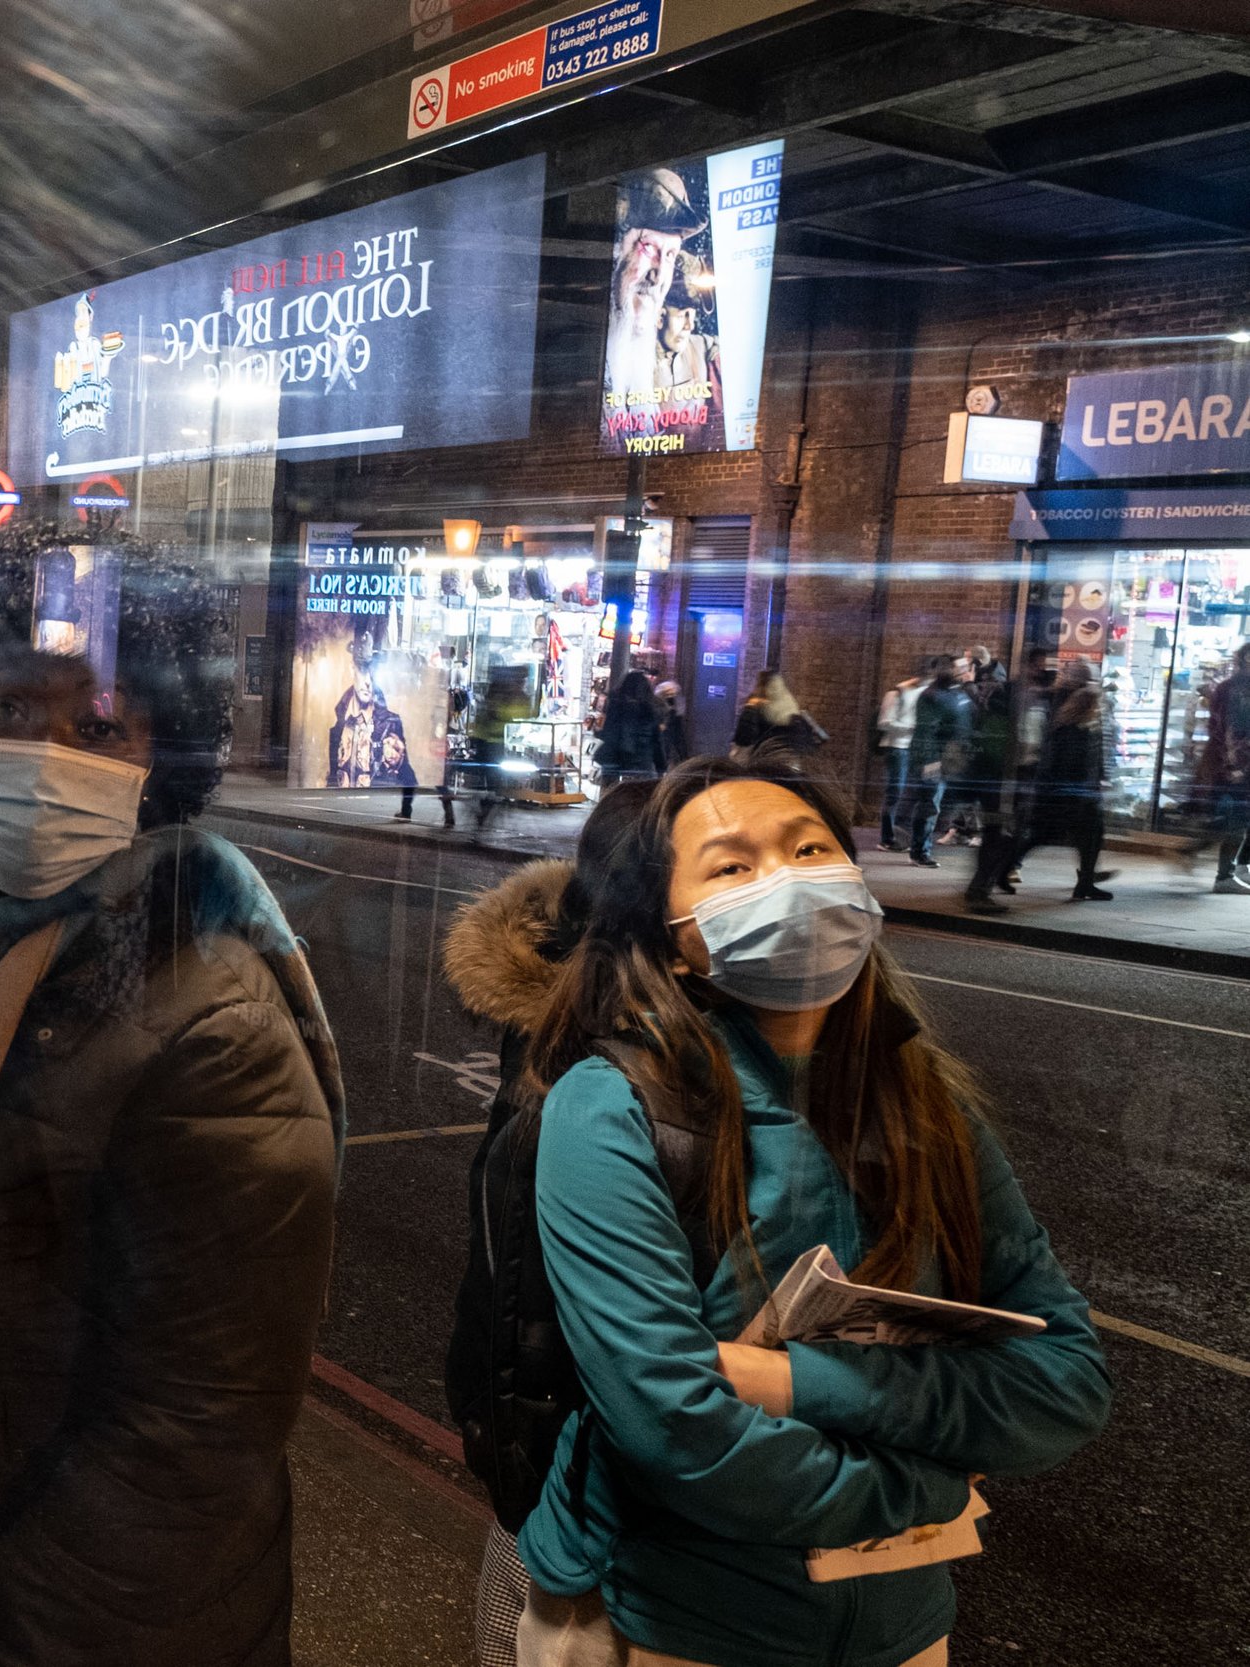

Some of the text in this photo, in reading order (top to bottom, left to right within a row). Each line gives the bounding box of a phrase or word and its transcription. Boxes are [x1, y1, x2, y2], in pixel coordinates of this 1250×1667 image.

[550, 43, 557, 54] is
[599, 21, 628, 39] please
[630, 12, 649, 26] call:
[551, 1, 641, 41] If bus stop or shelter
[546, 32, 649, 81] 0343 222 8888
[455, 57, 536, 99] No smoking
[972, 451, 1032, 477] LEBARA
[1029, 508, 1094, 521] TOBACCO
[1101, 507, 1154, 520] OYSTER
